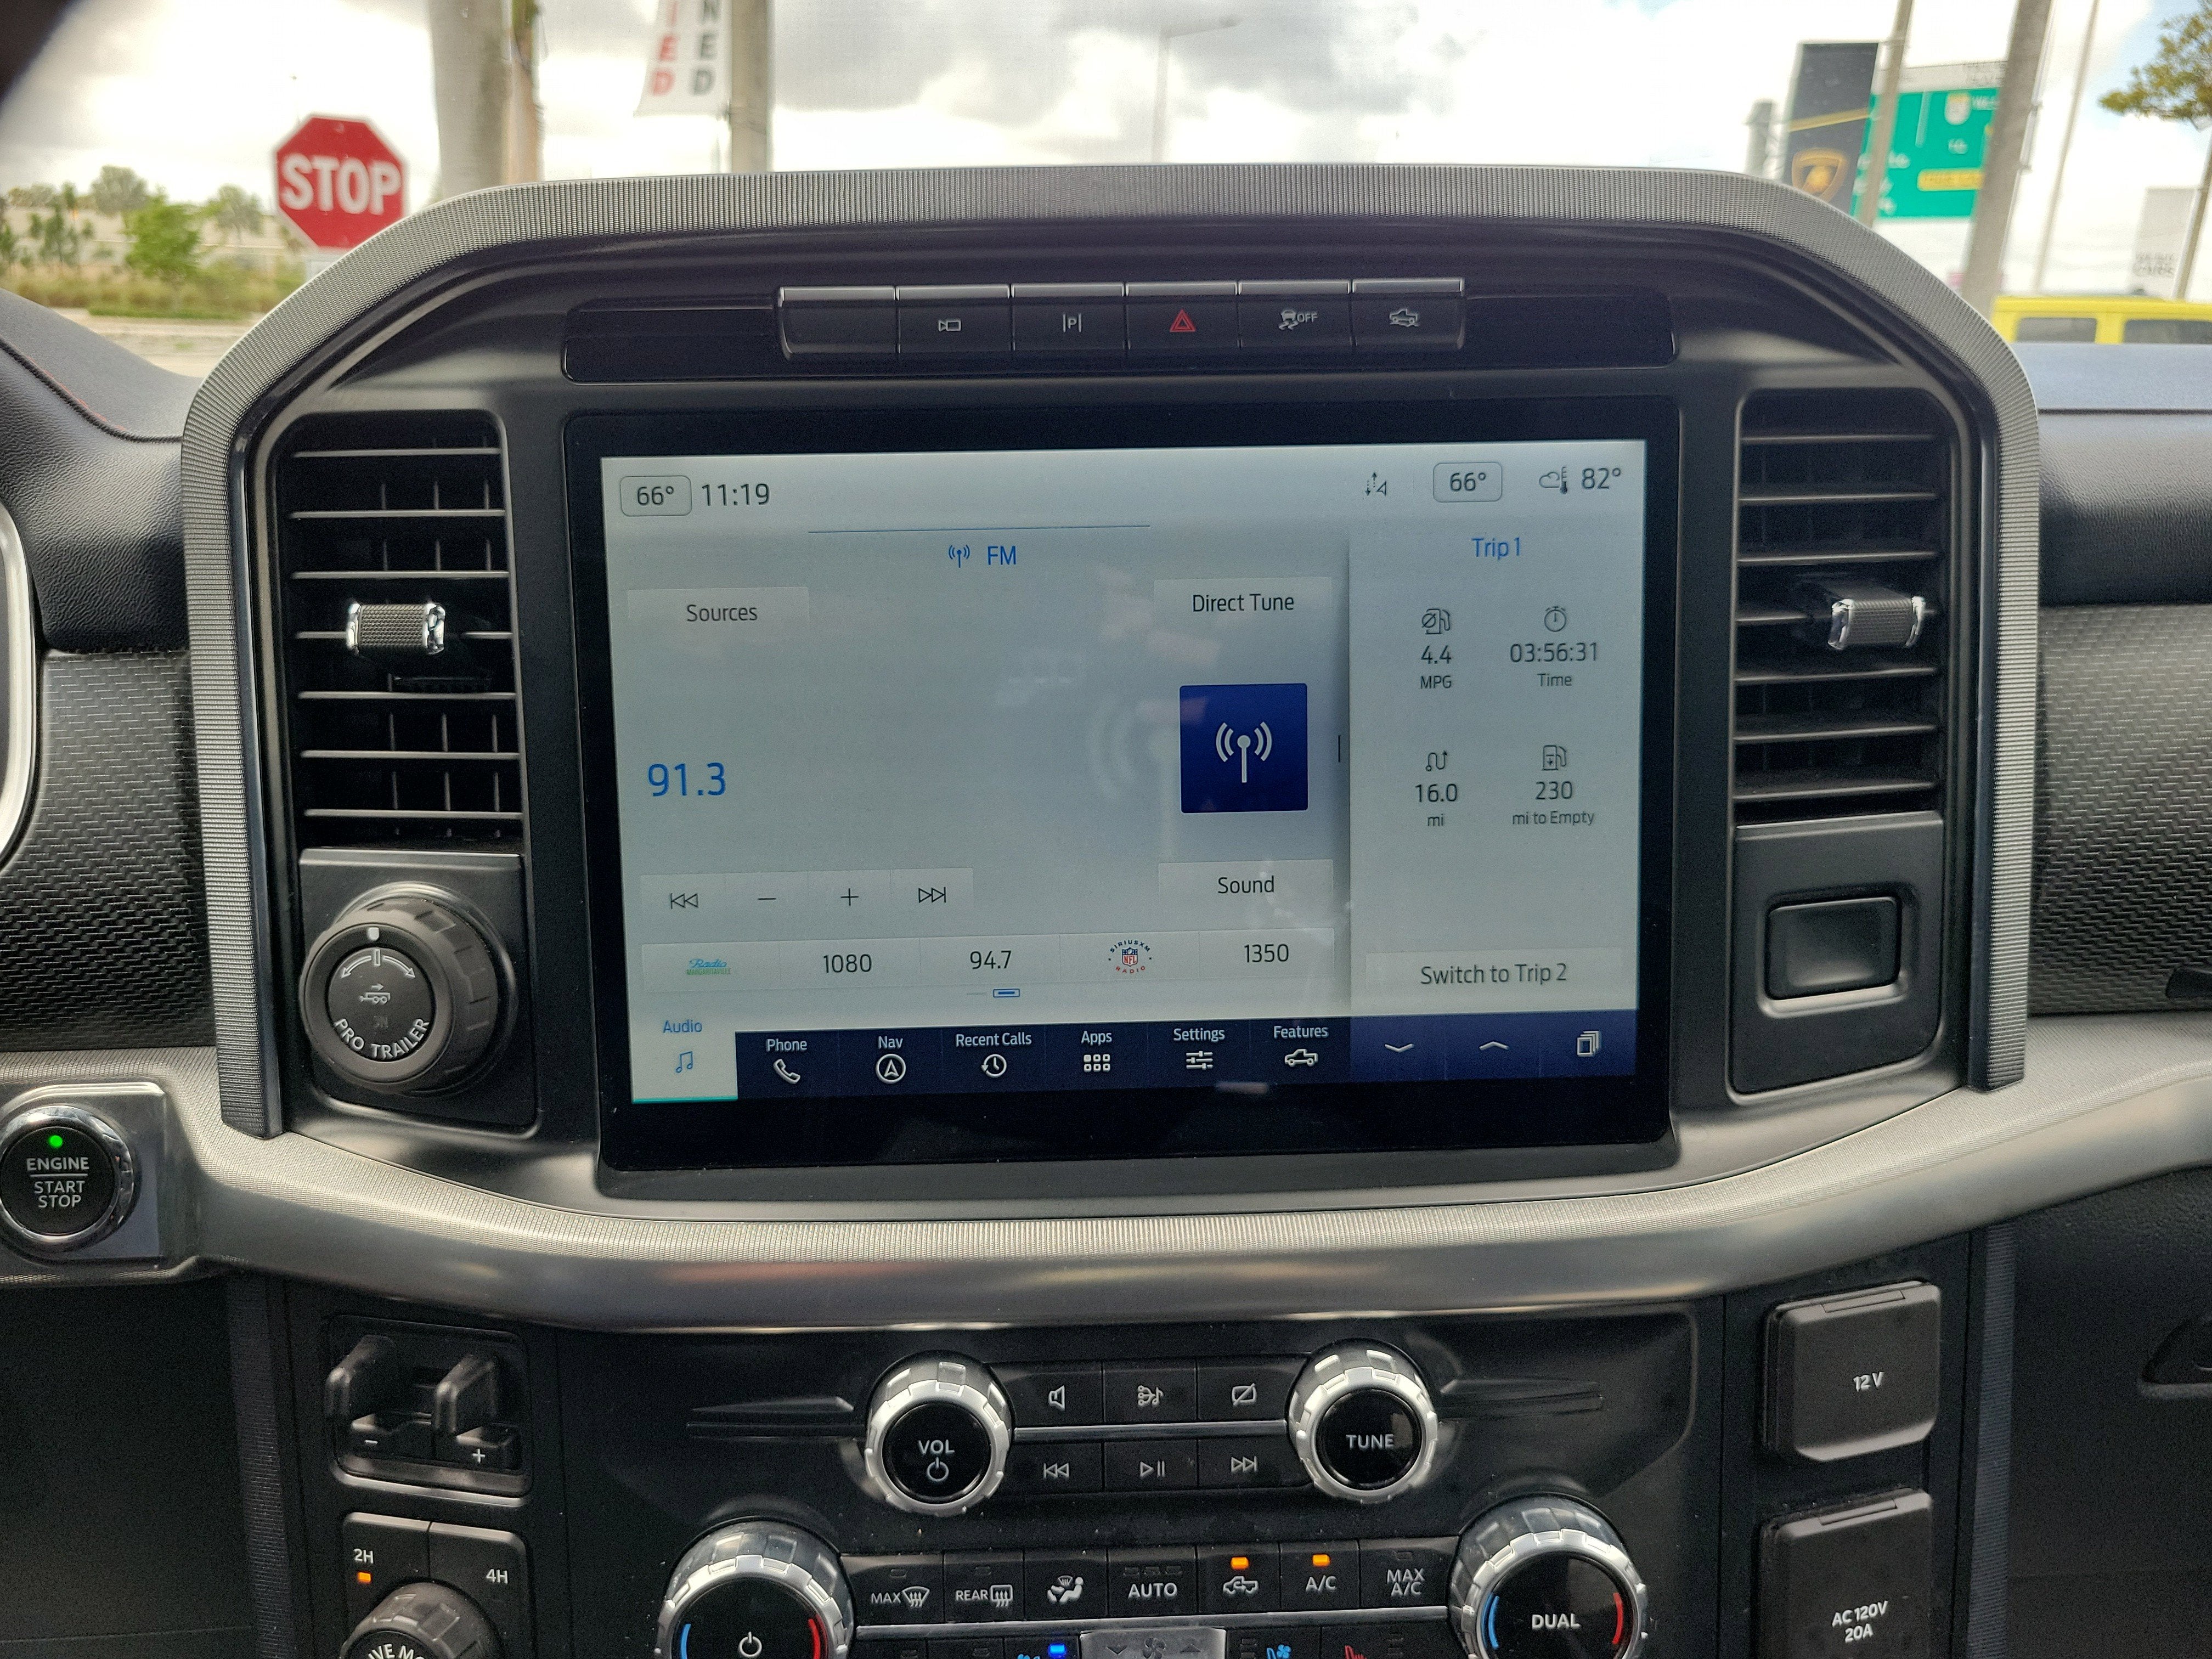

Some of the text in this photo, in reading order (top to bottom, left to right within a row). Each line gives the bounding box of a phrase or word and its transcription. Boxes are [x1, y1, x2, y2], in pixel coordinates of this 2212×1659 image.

[281, 153, 403, 216] STOP
[1297, 311, 1319, 323] OFF
[702, 483, 770, 506] 11:19
[988, 546, 1017, 566] FM
[1471, 538, 1521, 560] Trip 1
[1193, 594, 1294, 612] Direct Tune
[687, 605, 758, 622] Sources
[1421, 645, 1452, 664] 4.4
[1510, 642, 1598, 662] 03:56:31
[1420, 676, 1452, 689] MPG
[1538, 674, 1572, 686] Time
[648, 762, 726, 797] 91.3
[1415, 783, 1458, 802] 16.0
[1536, 781, 1573, 800] 230
[1427, 814, 1444, 826] mi
[1513, 811, 1595, 826] mi to Empty
[1218, 876, 1274, 894] Sound
[1110, 940, 1150, 953] SIRIUSXM
[1244, 944, 1289, 963] 1350
[690, 958, 727, 968] Radio
[823, 954, 872, 974] 1080
[970, 951, 1012, 970] 94.7
[1124, 956, 1136, 964] NFL
[1420, 963, 1567, 985] Switch to Trip 2
[663, 1019, 703, 1033] Audio
[1274, 1025, 1328, 1040] Features
[334, 1018, 430, 1059] PRO TRAILER
[878, 1036, 903, 1049] Nav
[955, 1032, 1032, 1047] Recent Calls
[1081, 1031, 1113, 1045] Apps
[1173, 1028, 1224, 1043] Settings
[766, 1038, 807, 1052] Phone
[26, 1157, 89, 1171] ENGINE
[35, 1181, 85, 1194] START
[38, 1195, 81, 1208] STOP
[918, 1440, 954, 1454] VOL
[1346, 1434, 1393, 1449] TUNE
[354, 1549, 374, 1564] 2H
[486, 1568, 508, 1583] 4H
[1387, 1568, 1423, 1583] MAX
[1128, 1582, 1177, 1598] AUTO
[1306, 1576, 1337, 1592] A/C
[1391, 1581, 1421, 1596] A/C
[871, 1591, 900, 1604] MAX
[956, 1589, 988, 1602] REAR
[1532, 1613, 1579, 1629] DUAL
[1832, 1601, 1888, 1627] AC 120V
[1845, 1624, 1873, 1643] 20A
[398, 1645, 425, 1659] M
